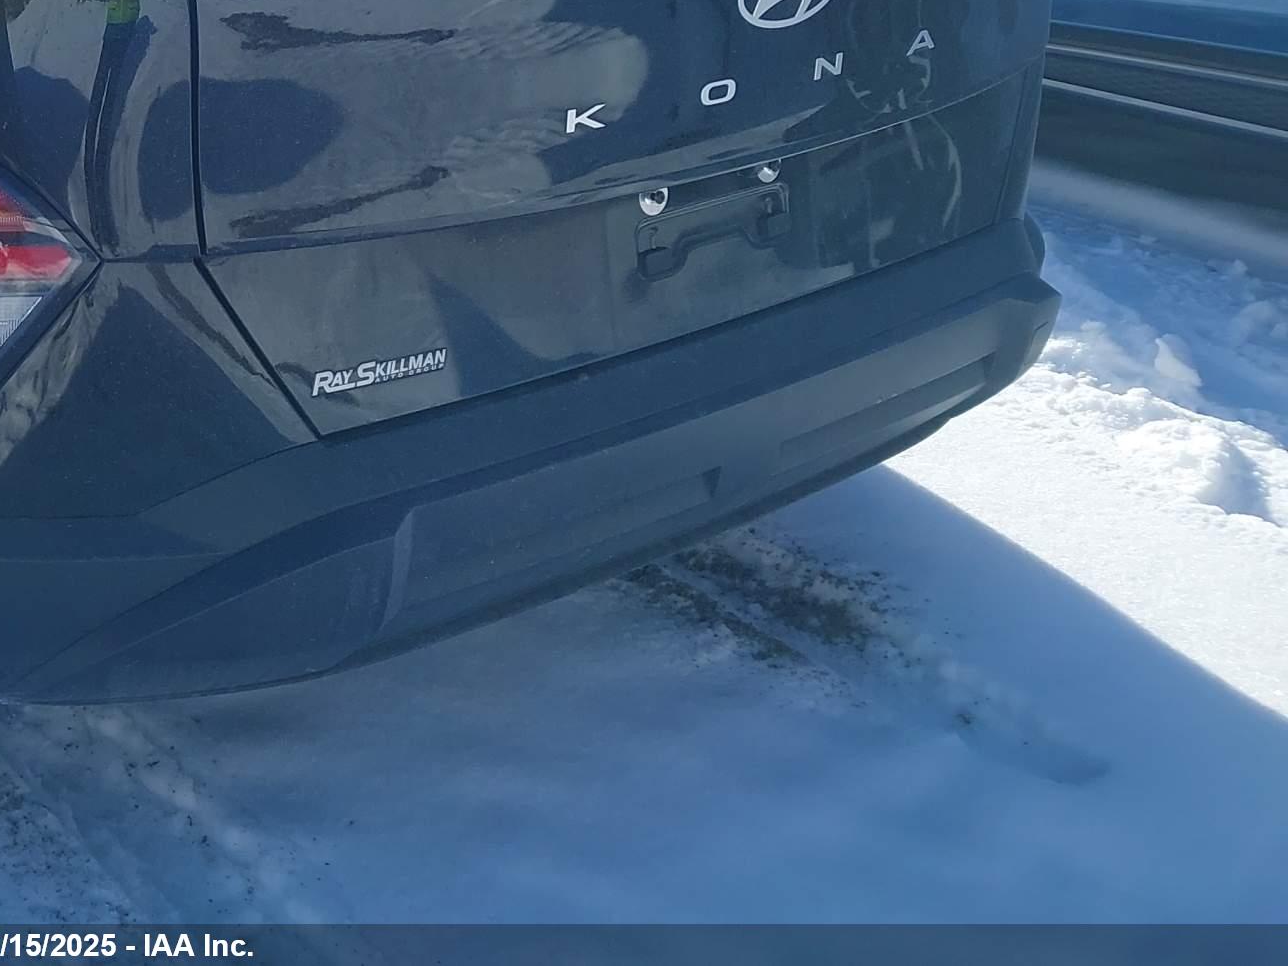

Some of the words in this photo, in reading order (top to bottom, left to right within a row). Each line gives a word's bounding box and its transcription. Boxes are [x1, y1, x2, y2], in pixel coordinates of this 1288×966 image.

[565, 29, 935, 135] KONA
[311, 370, 356, 397] RAY
[357, 348, 447, 388] SKILLMAN
